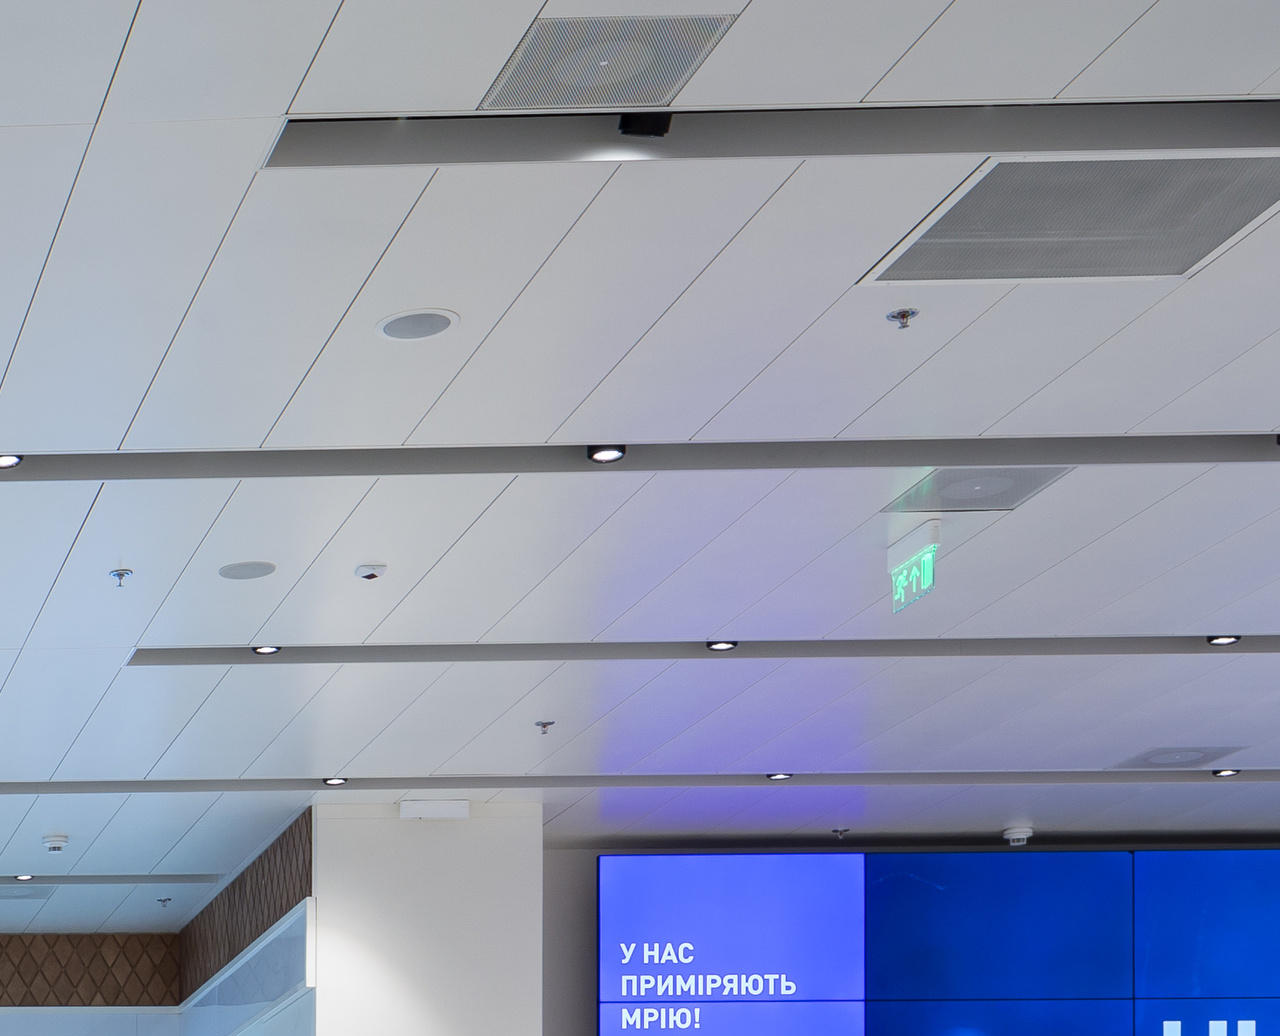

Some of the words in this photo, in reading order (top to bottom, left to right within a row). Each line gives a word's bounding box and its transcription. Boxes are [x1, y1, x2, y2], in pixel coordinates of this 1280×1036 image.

[619, 942, 637, 965] У
[643, 942, 695, 964] НАС
[621, 973, 797, 997] ПРИМІРЯЮТЬ
[621, 1007, 701, 1030] МРІЮ!
